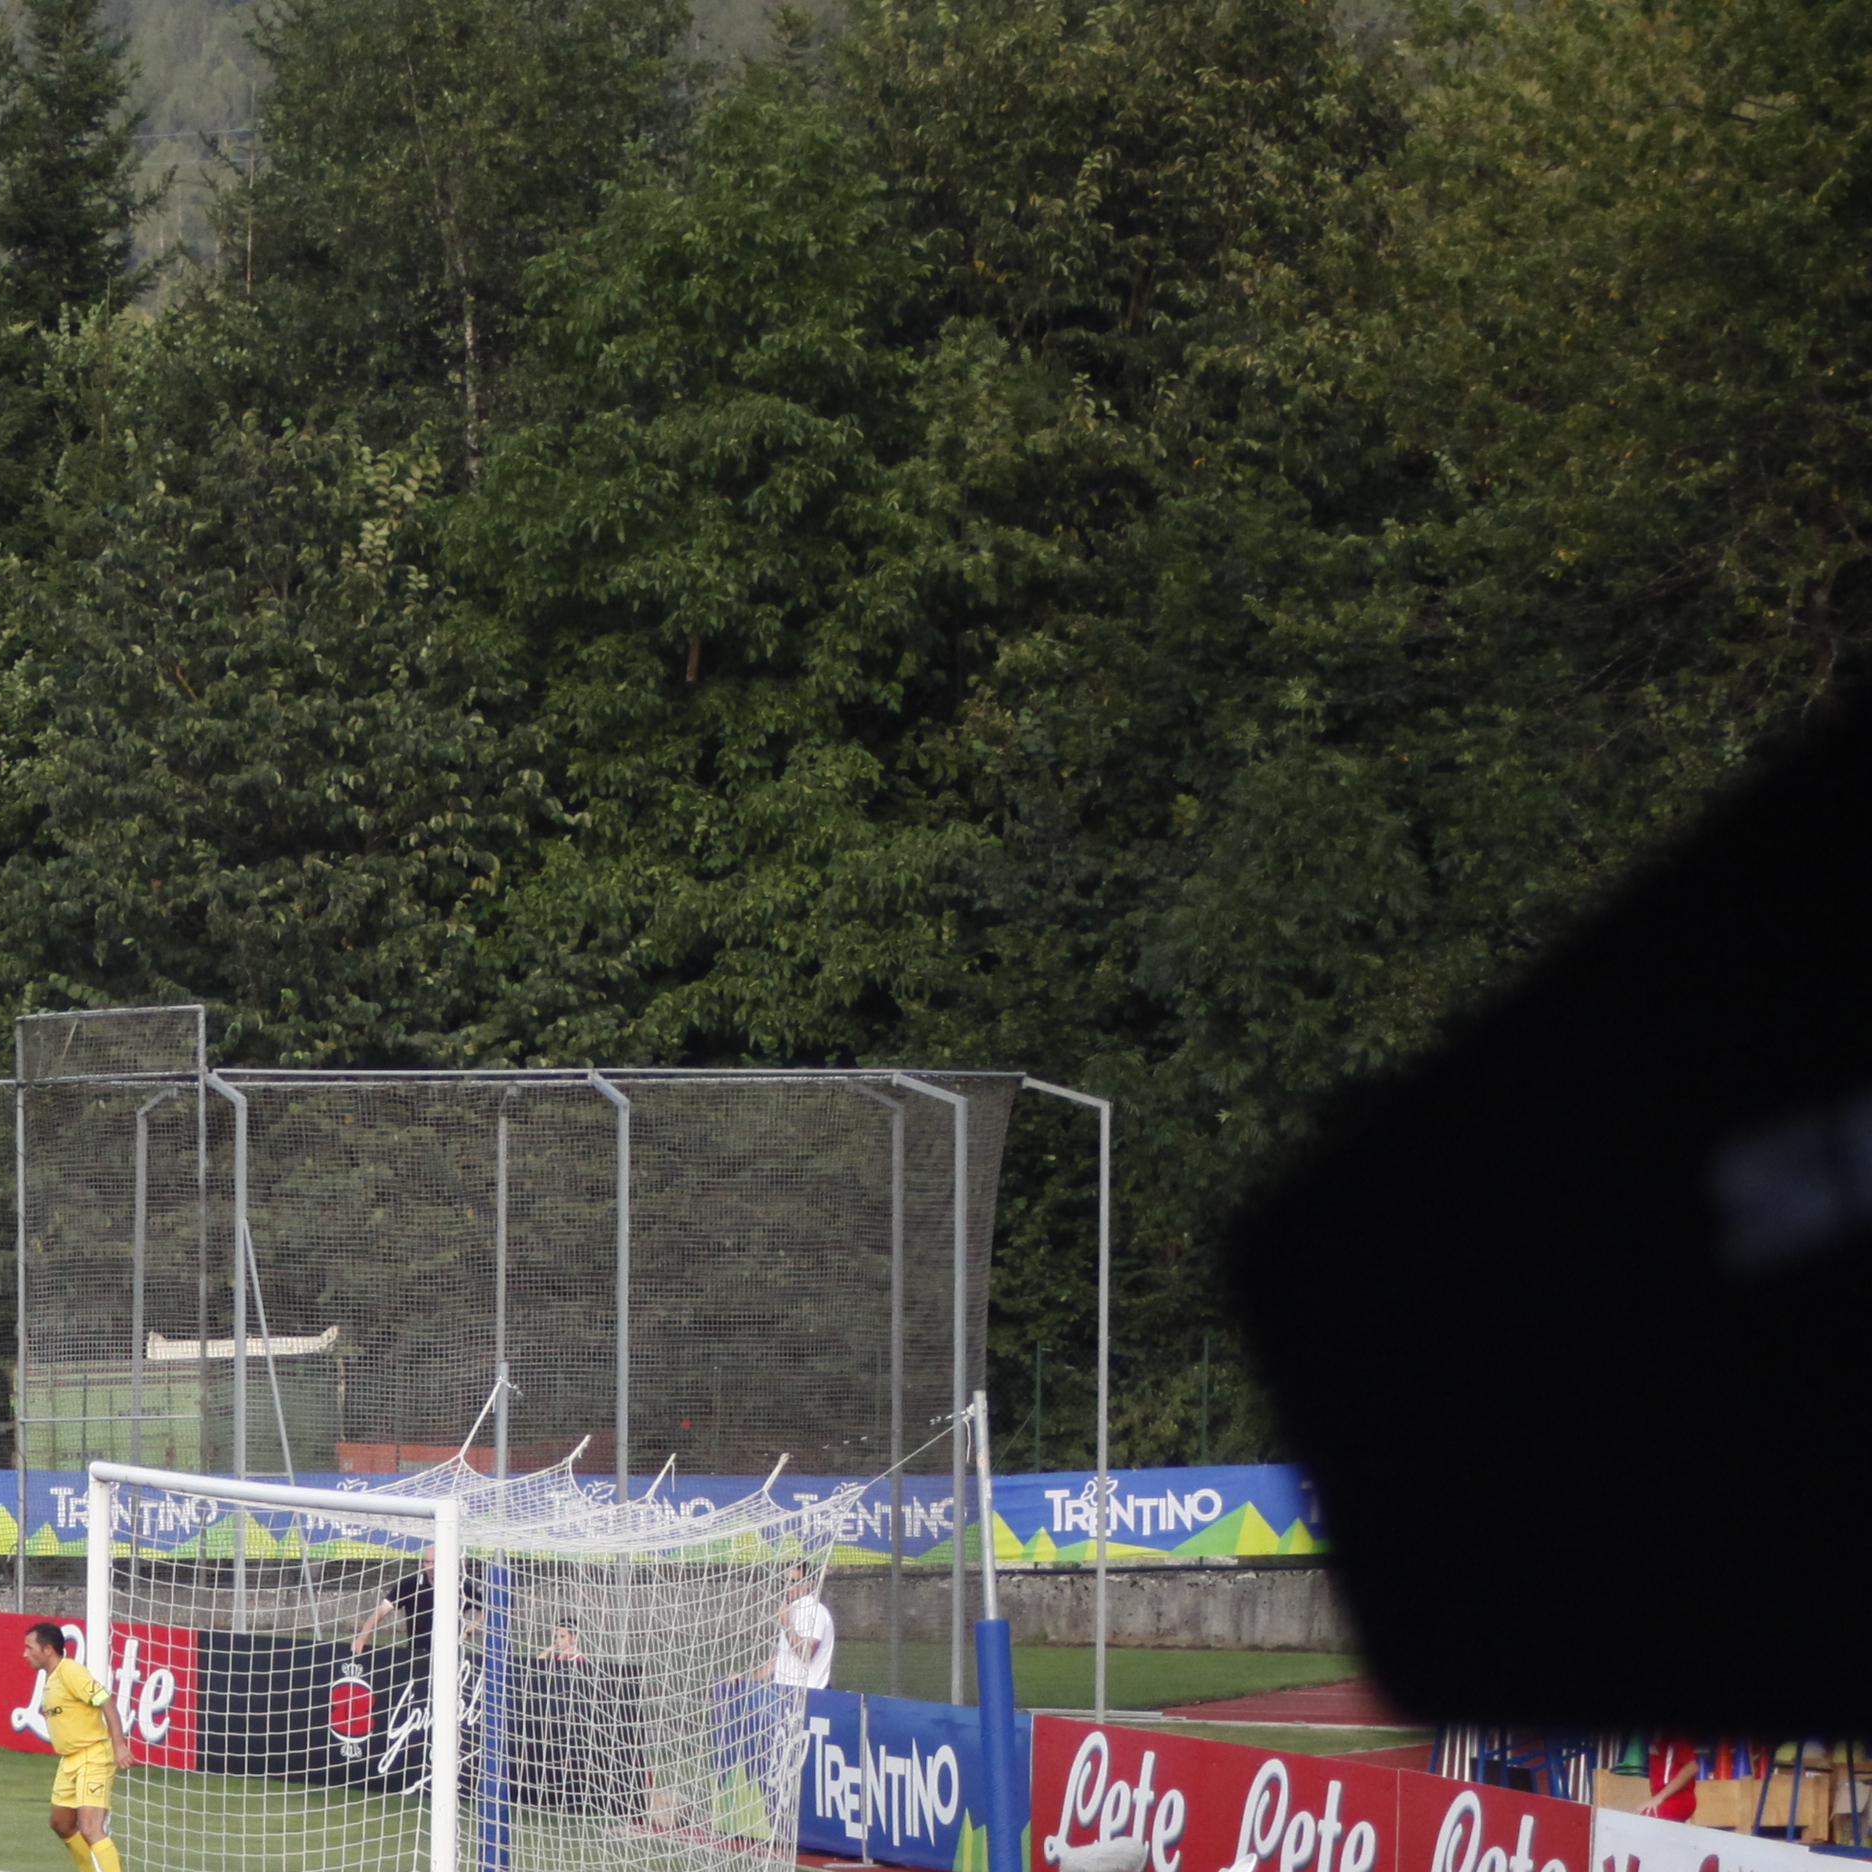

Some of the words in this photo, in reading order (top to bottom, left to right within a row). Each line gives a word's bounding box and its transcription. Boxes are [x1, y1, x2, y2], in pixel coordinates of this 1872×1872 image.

[49, 1486, 219, 1536] TRNTINO
[1044, 1488, 1223, 1537] TRENTINO
[809, 1716, 960, 1847] TRENTINO
